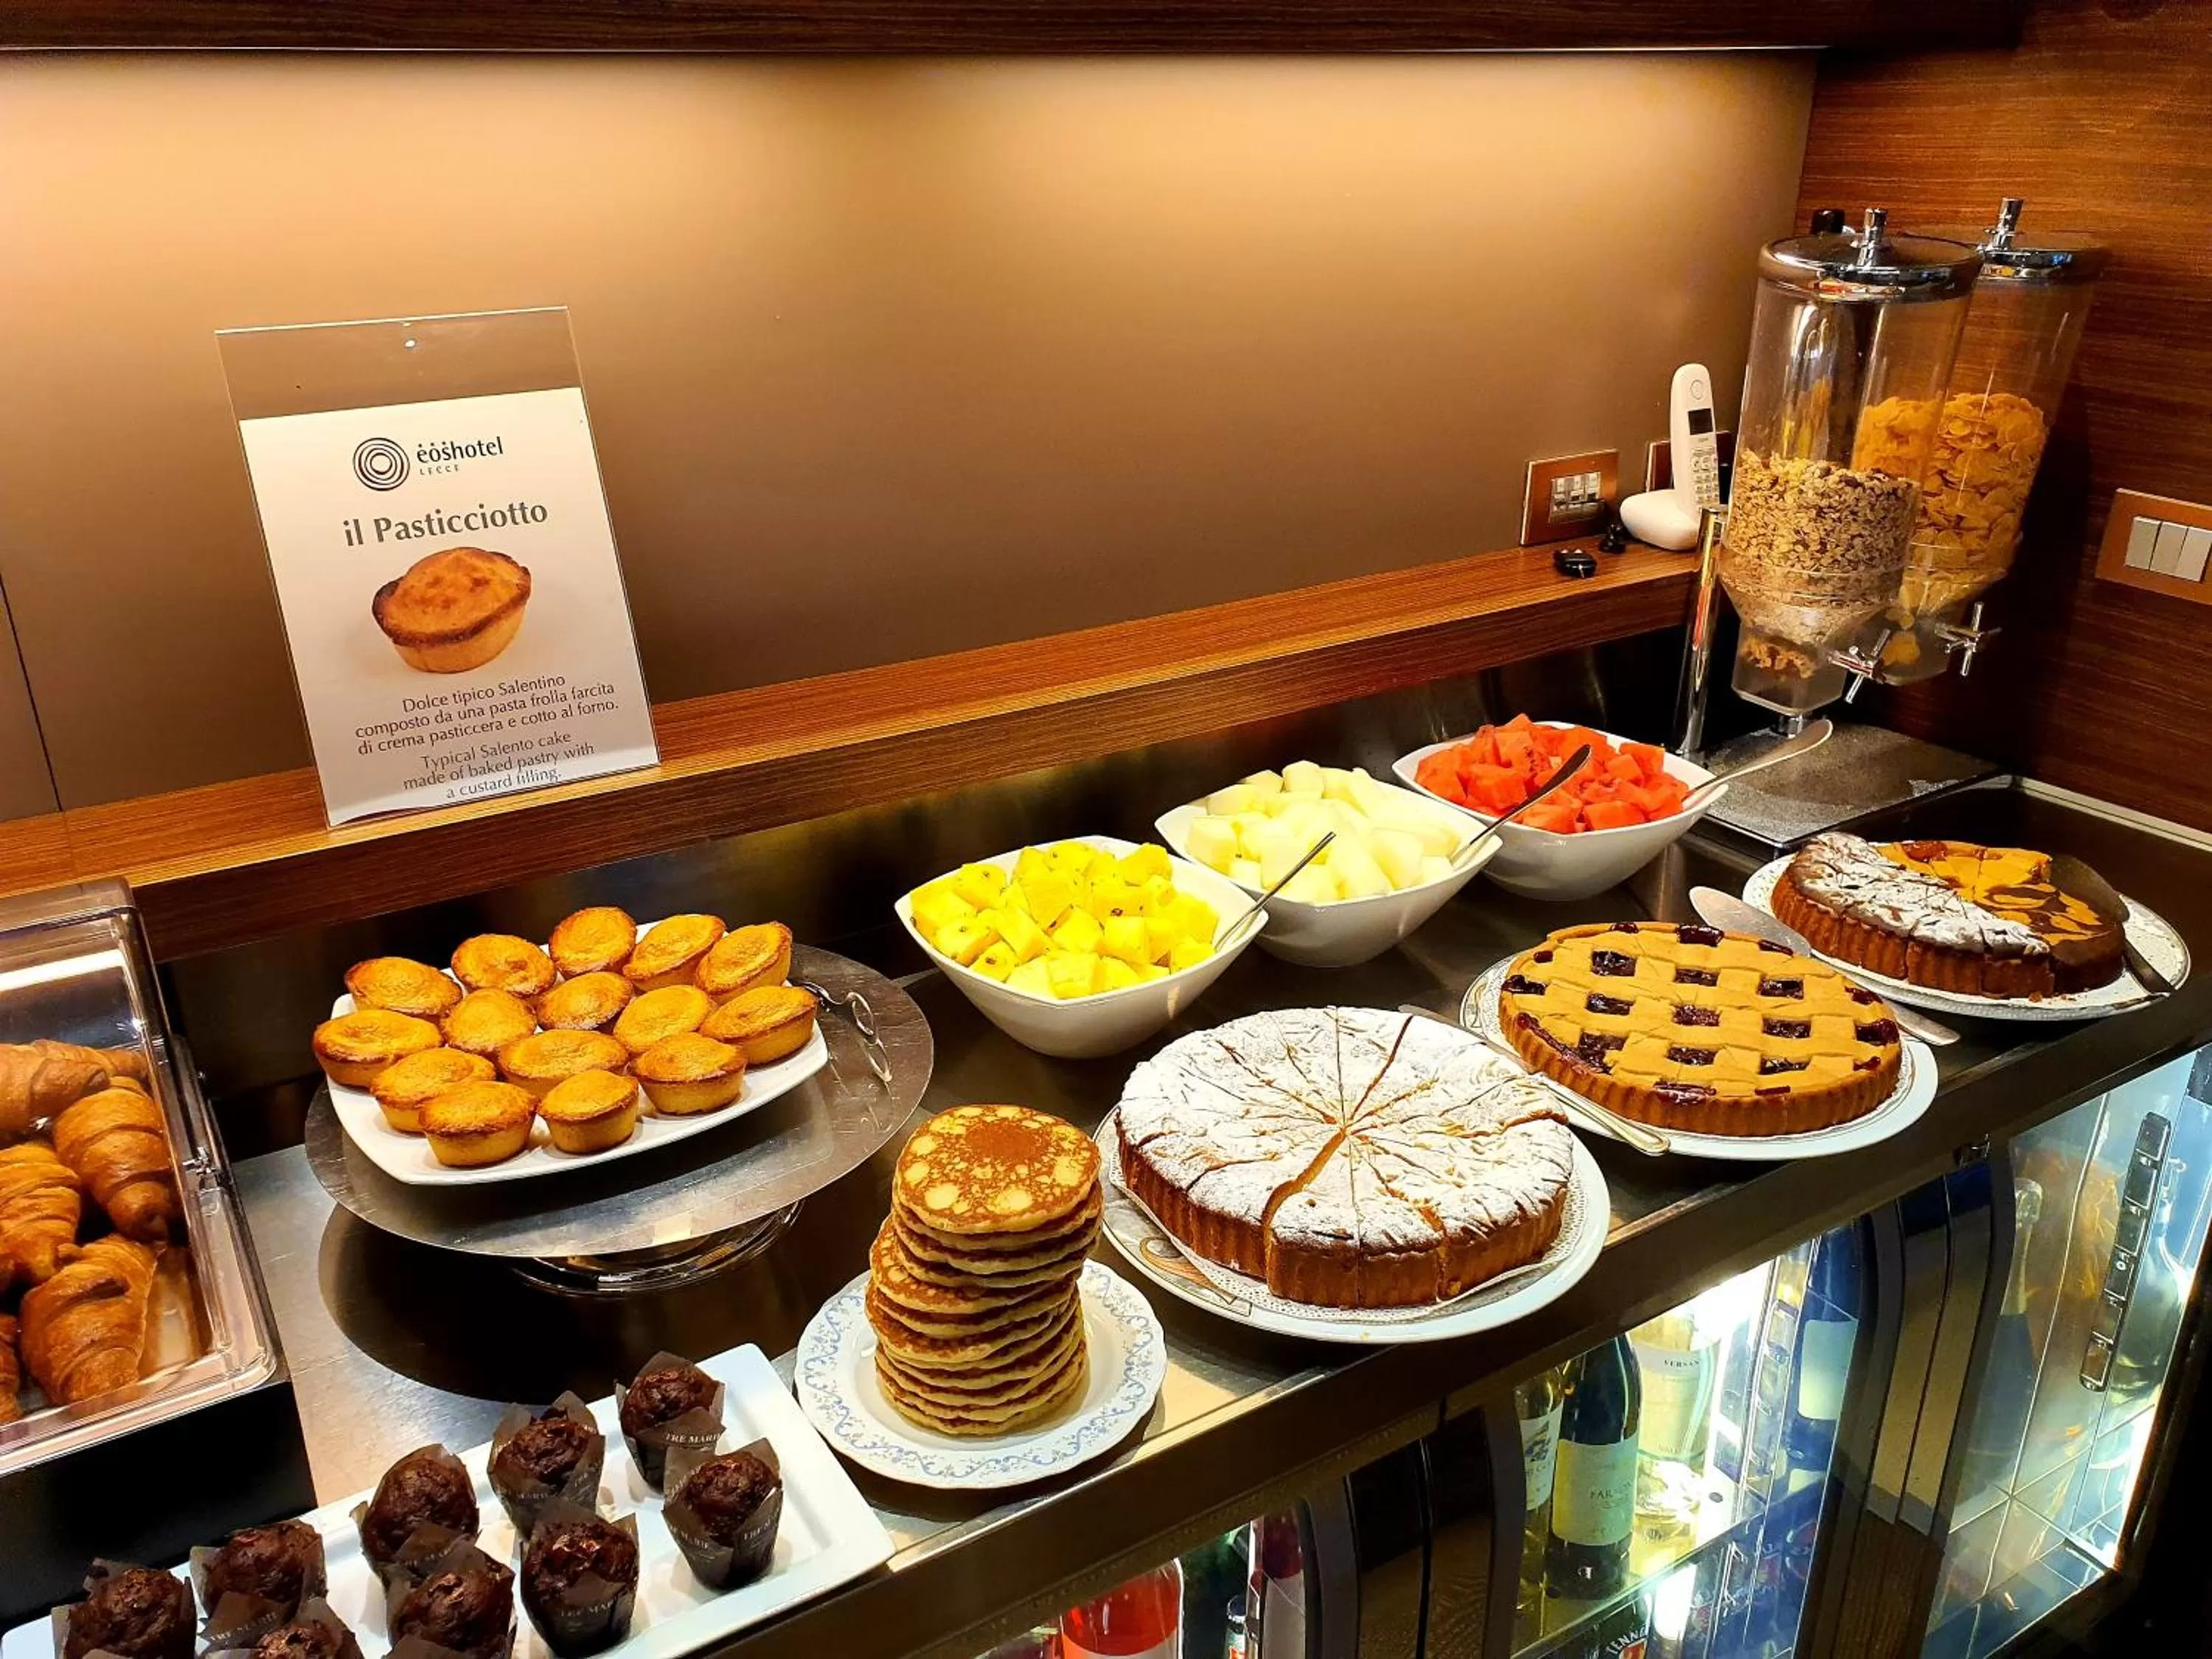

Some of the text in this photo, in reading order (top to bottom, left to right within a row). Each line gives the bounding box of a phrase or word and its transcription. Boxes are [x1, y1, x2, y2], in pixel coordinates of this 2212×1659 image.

[343, 501, 548, 546] il Pasticciotto
[355, 683, 614, 737] composto da una pasta frolla farcita
[402, 676, 566, 713] Dolce tipico Salentino
[358, 701, 619, 755] di crema pasticcera e cotto al forno.
[403, 743, 595, 790] made of baked pastry with
[421, 731, 571, 771] Typical Salento cake
[446, 768, 561, 799] a custard filling.
